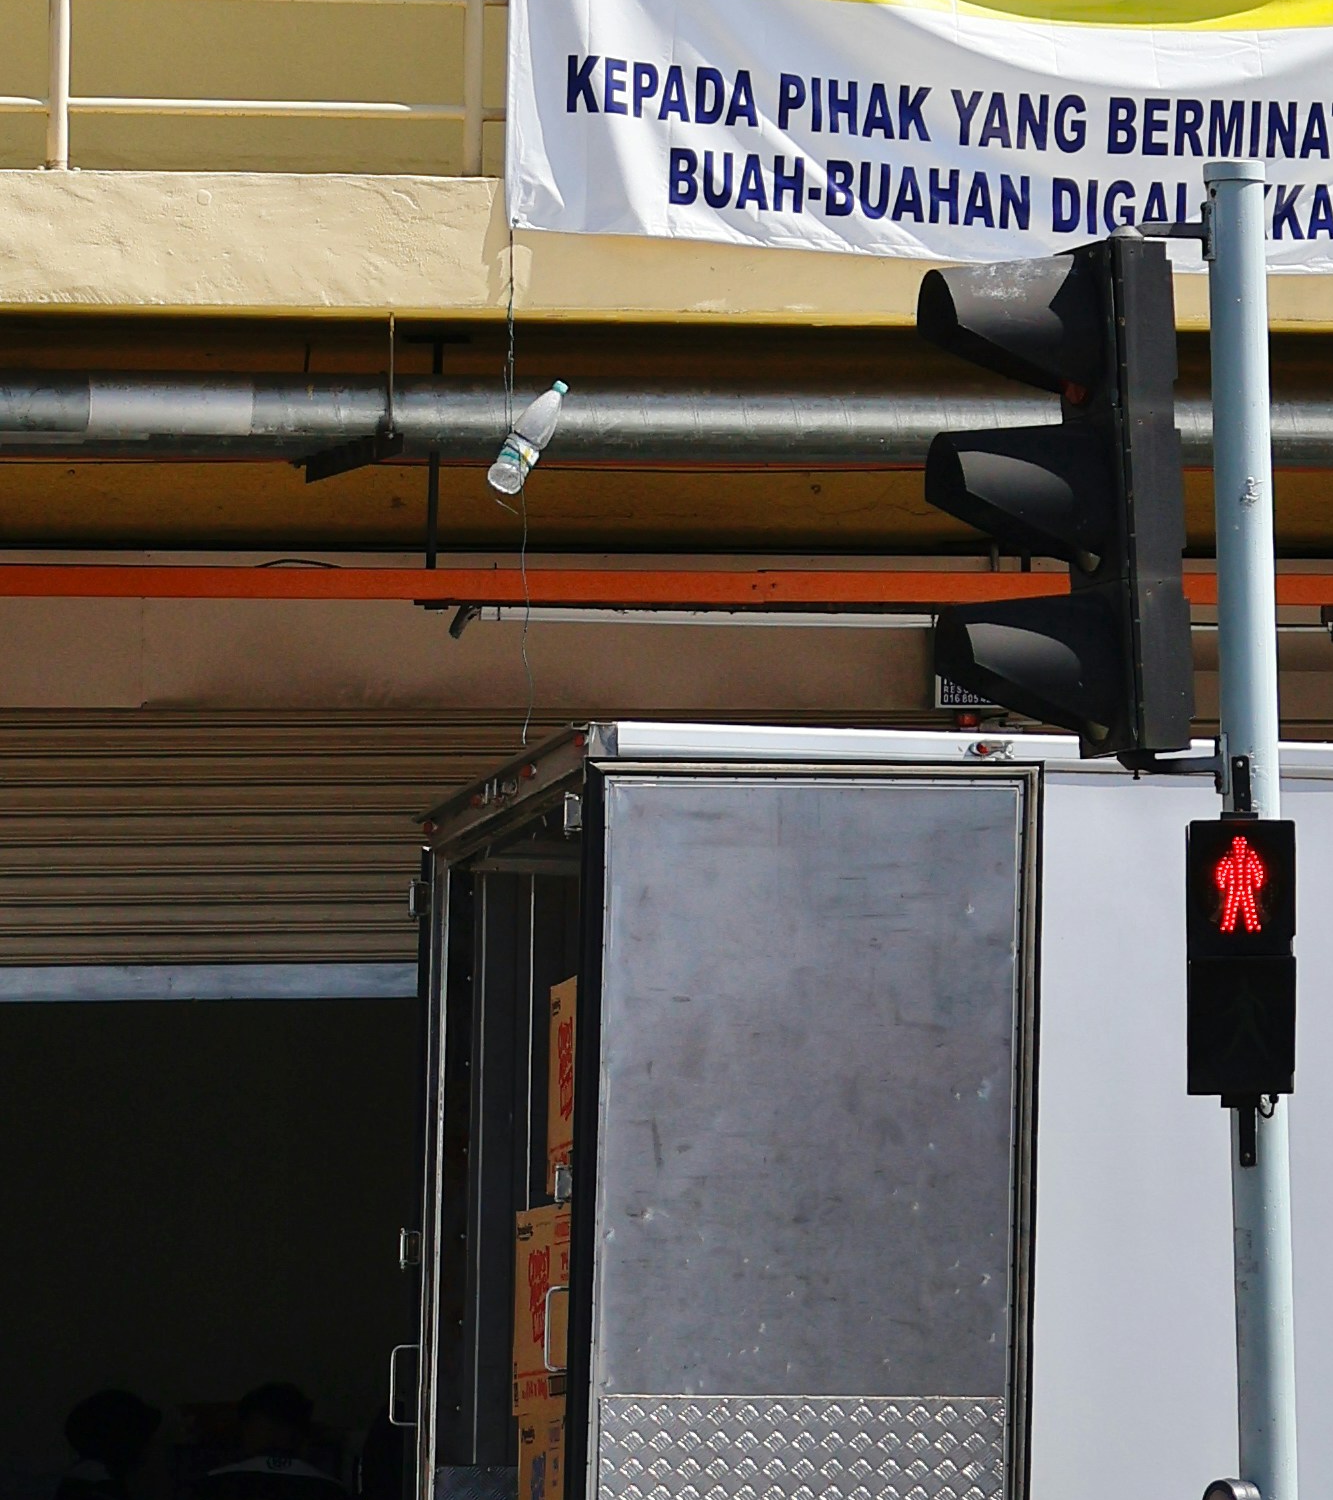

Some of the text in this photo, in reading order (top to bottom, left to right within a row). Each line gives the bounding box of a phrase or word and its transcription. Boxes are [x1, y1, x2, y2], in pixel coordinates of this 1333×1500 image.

[566, 54, 759, 128] KEPADA
[777, 72, 932, 142] PIHAK
[950, 89, 1087, 154] YANG
[668, 147, 1031, 231] BUAH-BUAHAN
